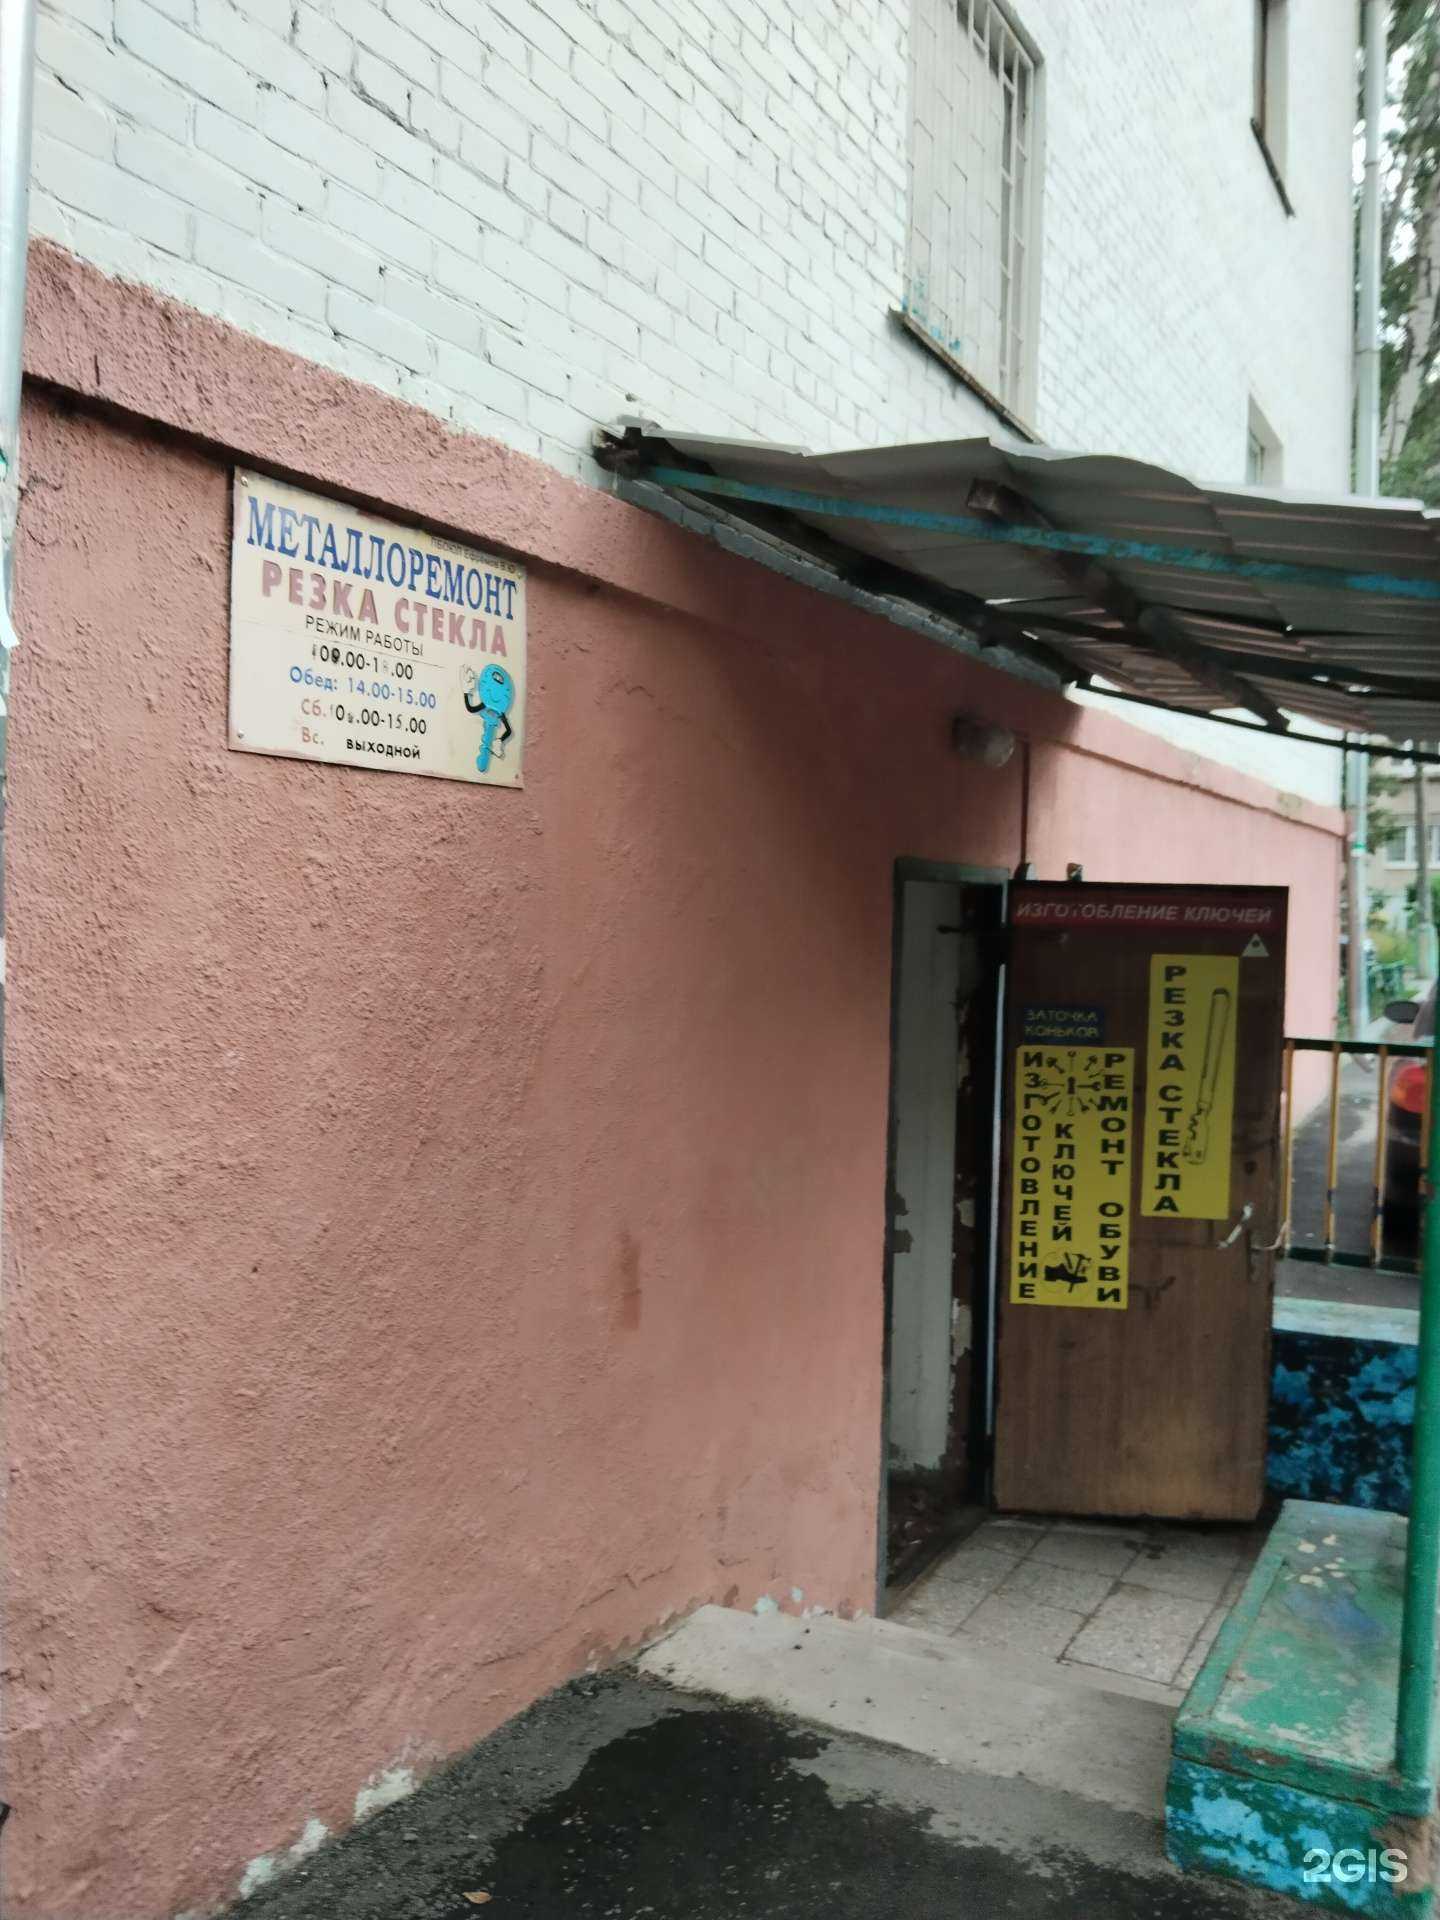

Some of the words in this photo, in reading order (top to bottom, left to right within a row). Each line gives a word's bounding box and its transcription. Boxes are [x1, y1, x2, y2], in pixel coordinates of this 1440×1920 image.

[246, 496, 518, 620] МЕТАЛЛОРЕМОНТ
[261, 560, 379, 625] РЕЗКА
[394, 598, 508, 657] СТЕКЛА
[289, 665, 338, 691] Обед:
[348, 677, 437, 709] 14.00-15.00
[305, 614, 361, 642] РЕЖИМ
[366, 629, 424, 656] РАБОТЫ
[346, 738, 421, 760] выходной
[1158, 965, 1187, 1072] РЕЗКА
[1099, 1053, 1129, 1176] РЕМОНТ
[1153, 1084, 1183, 1213] СТЕКЛА
[1018, 1051, 1044, 1300] ИЗГОТОВЛЕНИЕ
[1051, 1122, 1076, 1242] КЛЮЧЕЙ
[1096, 1201, 1125, 1303] ОБУВИ
